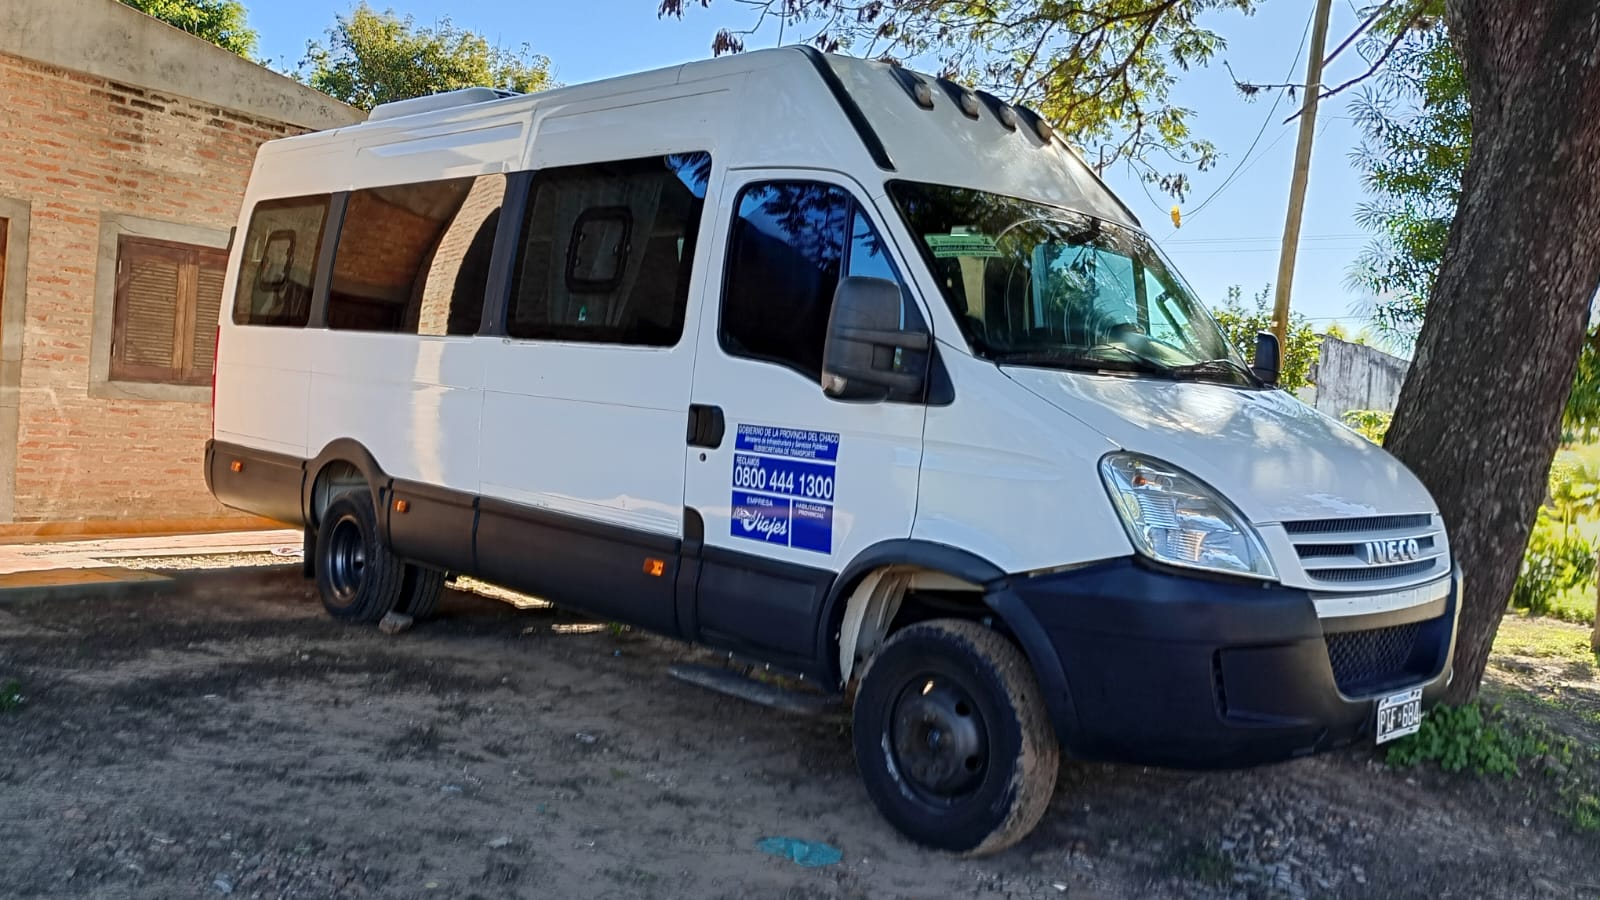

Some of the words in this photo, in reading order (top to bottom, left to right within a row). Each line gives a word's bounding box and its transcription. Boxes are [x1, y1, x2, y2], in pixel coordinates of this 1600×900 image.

[738, 425, 764, 436] GOBIERNO
[764, 427, 772, 437] DE
[772, 428, 779, 437] LA
[779, 429, 807, 440] PROVINCIA
[808, 431, 818, 441] DEL
[819, 432, 839, 443] CHACO
[784, 447, 790, 455] DE
[790, 448, 816, 458] TRANSPORTE
[736, 455, 760, 467] RECLAMOS
[734, 466, 766, 489] 0800
[769, 469, 795, 494] 444
[799, 473, 833, 499] 1300
[746, 496, 773, 507] EMPRESA
[798, 510, 825, 519] PROVINCIAL
[743, 509, 787, 541] Viajes
[1366, 538, 1419, 564] IVECO
